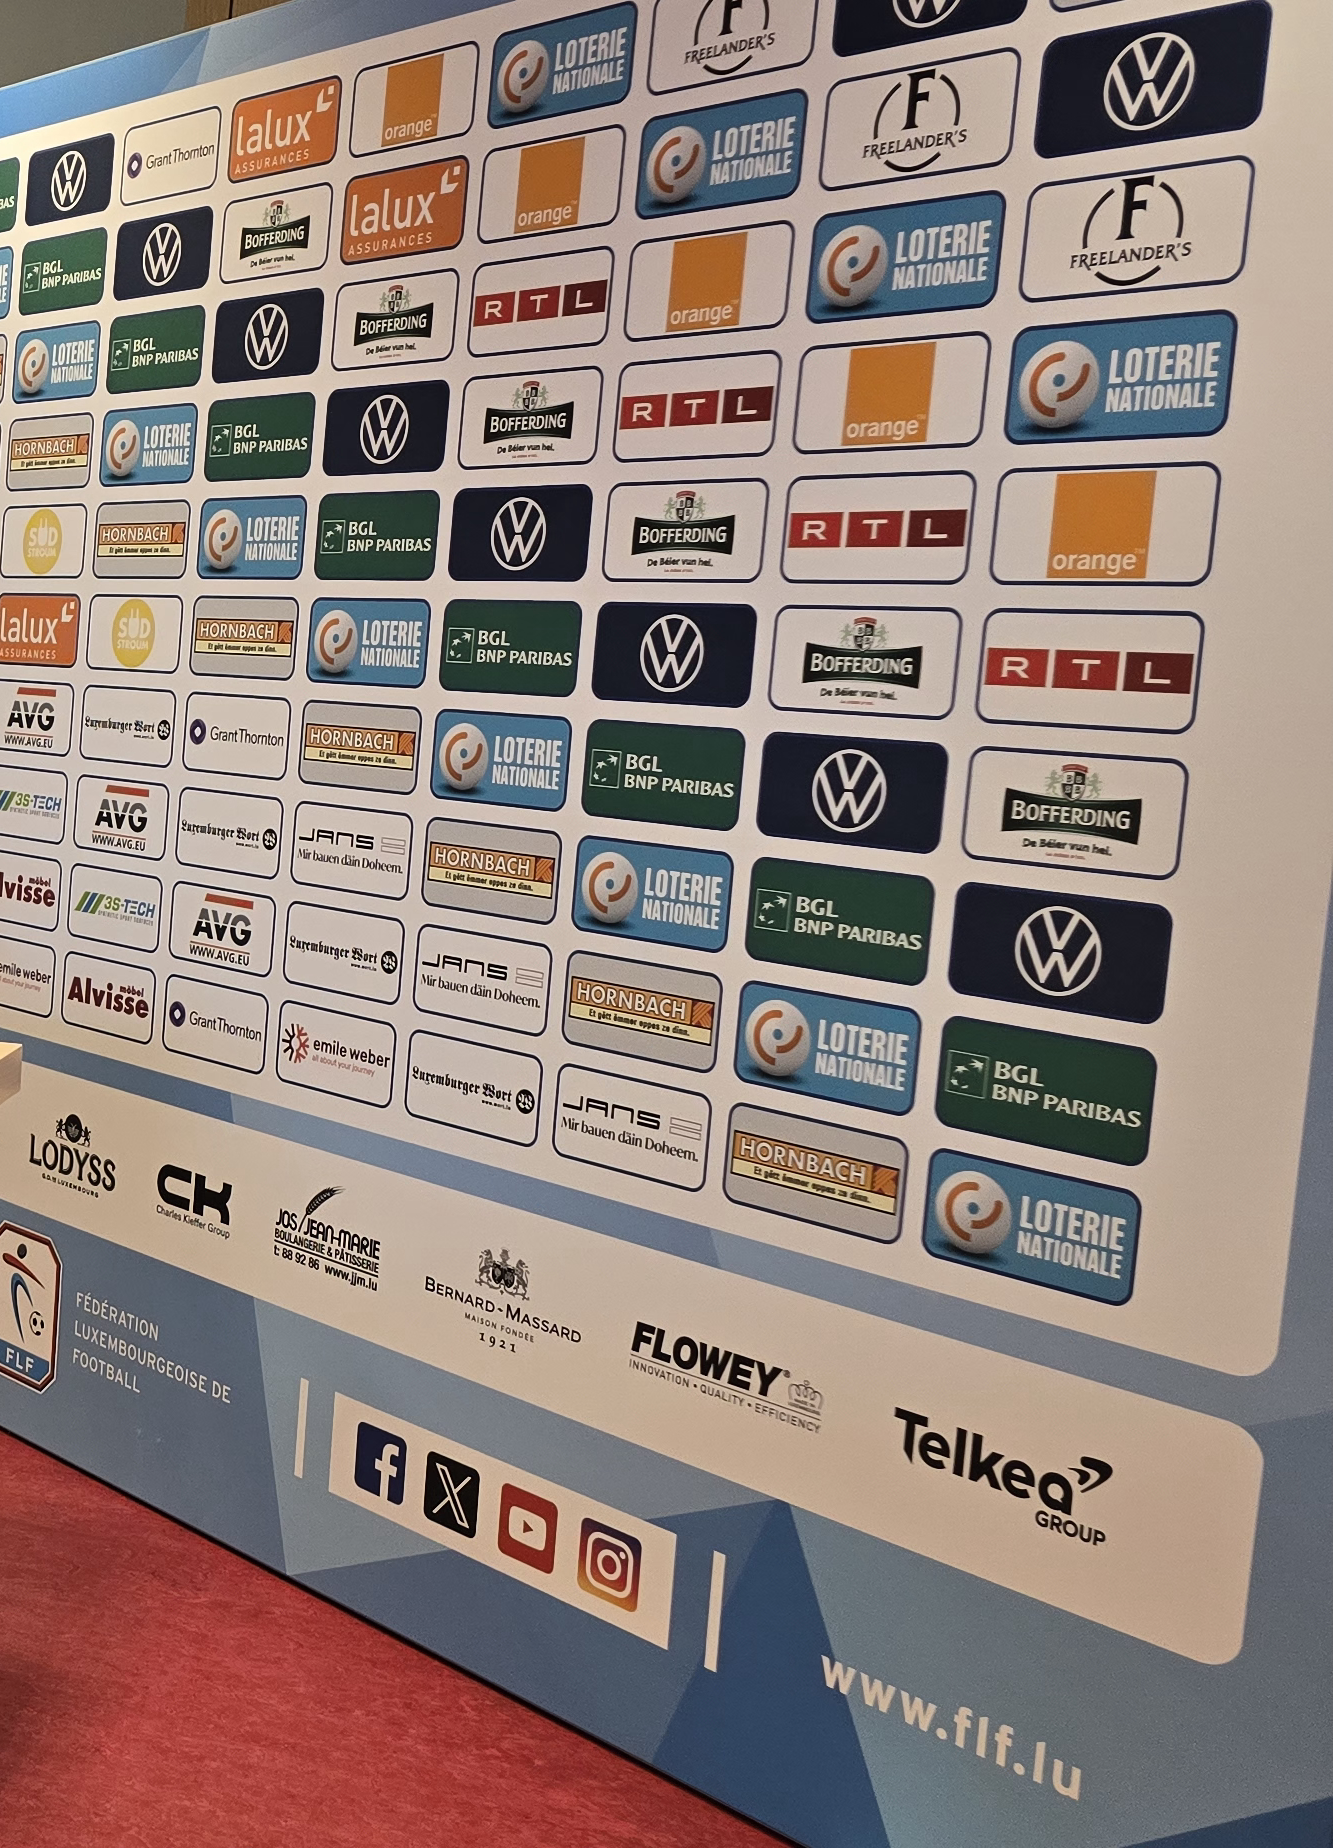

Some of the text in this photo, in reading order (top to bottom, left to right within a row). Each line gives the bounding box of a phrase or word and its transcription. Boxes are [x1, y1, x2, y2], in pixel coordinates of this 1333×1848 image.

[553, 28, 627, 72] LOTERIE
[552, 57, 625, 95] NATIONALE
[236, 109, 311, 156] lalux
[385, 118, 433, 141] orange
[235, 149, 310, 174] ASSURANCES
[245, 226, 304, 250] BOFFERDING
[894, 219, 992, 262] LOTERIE
[1070, 240, 1192, 272] FREELANDER'S
[892, 254, 988, 292] NATIONALE
[639, 523, 728, 546] BOFFERDING
[1052, 548, 1137, 575] orange
[117, 639, 148, 650] STROUM
[435, 847, 530, 877] HORNBACH
[193, 908, 252, 947] AVG
[189, 944, 250, 967] WWW.AVG.EU
[421, 974, 540, 1009] Mir bauen däin Doheem.
[576, 982, 686, 1020] HORNBACH
[313, 1040, 390, 1067] emile weber
[817, 1019, 909, 1066] LOTERIE
[815, 1053, 905, 1091] NATIONALE
[995, 1061, 1045, 1088] BGL
[992, 1084, 1142, 1128] BNP PARIBAS
[29, 1133, 116, 1191] LODYSS
[157, 1164, 232, 1225] CK
[156, 1205, 230, 1240] Charles Kieffer Group
[275, 1228, 325, 1256] BOULANGERIE
[327, 1245, 333, 1257] &
[281, 1247, 294, 1261] 88
[295, 1253, 307, 1266] 92
[309, 1258, 319, 1271] 86
[325, 1265, 377, 1291] www.jjm.lu
[76, 1292, 159, 1341] FÉDÉRATION
[465, 1312, 534, 1342] MAISON FONDÉE
[5, 1347, 34, 1373] FLF
[479, 1332, 516, 1352] 1921
[73, 1349, 140, 1393] FOOTBALL
[75, 1321, 231, 1403] LUXEMBOURGEOISE DE
[629, 1359, 690, 1388] INNOVATION
[700, 1383, 744, 1407] QUALITY
[755, 1403, 821, 1433] EFFICIENCY
[895, 1407, 1074, 1515] Telkea
[1035, 1511, 1106, 1546] GROUP
[821, 1655, 1081, 1801] www.flf.lu
